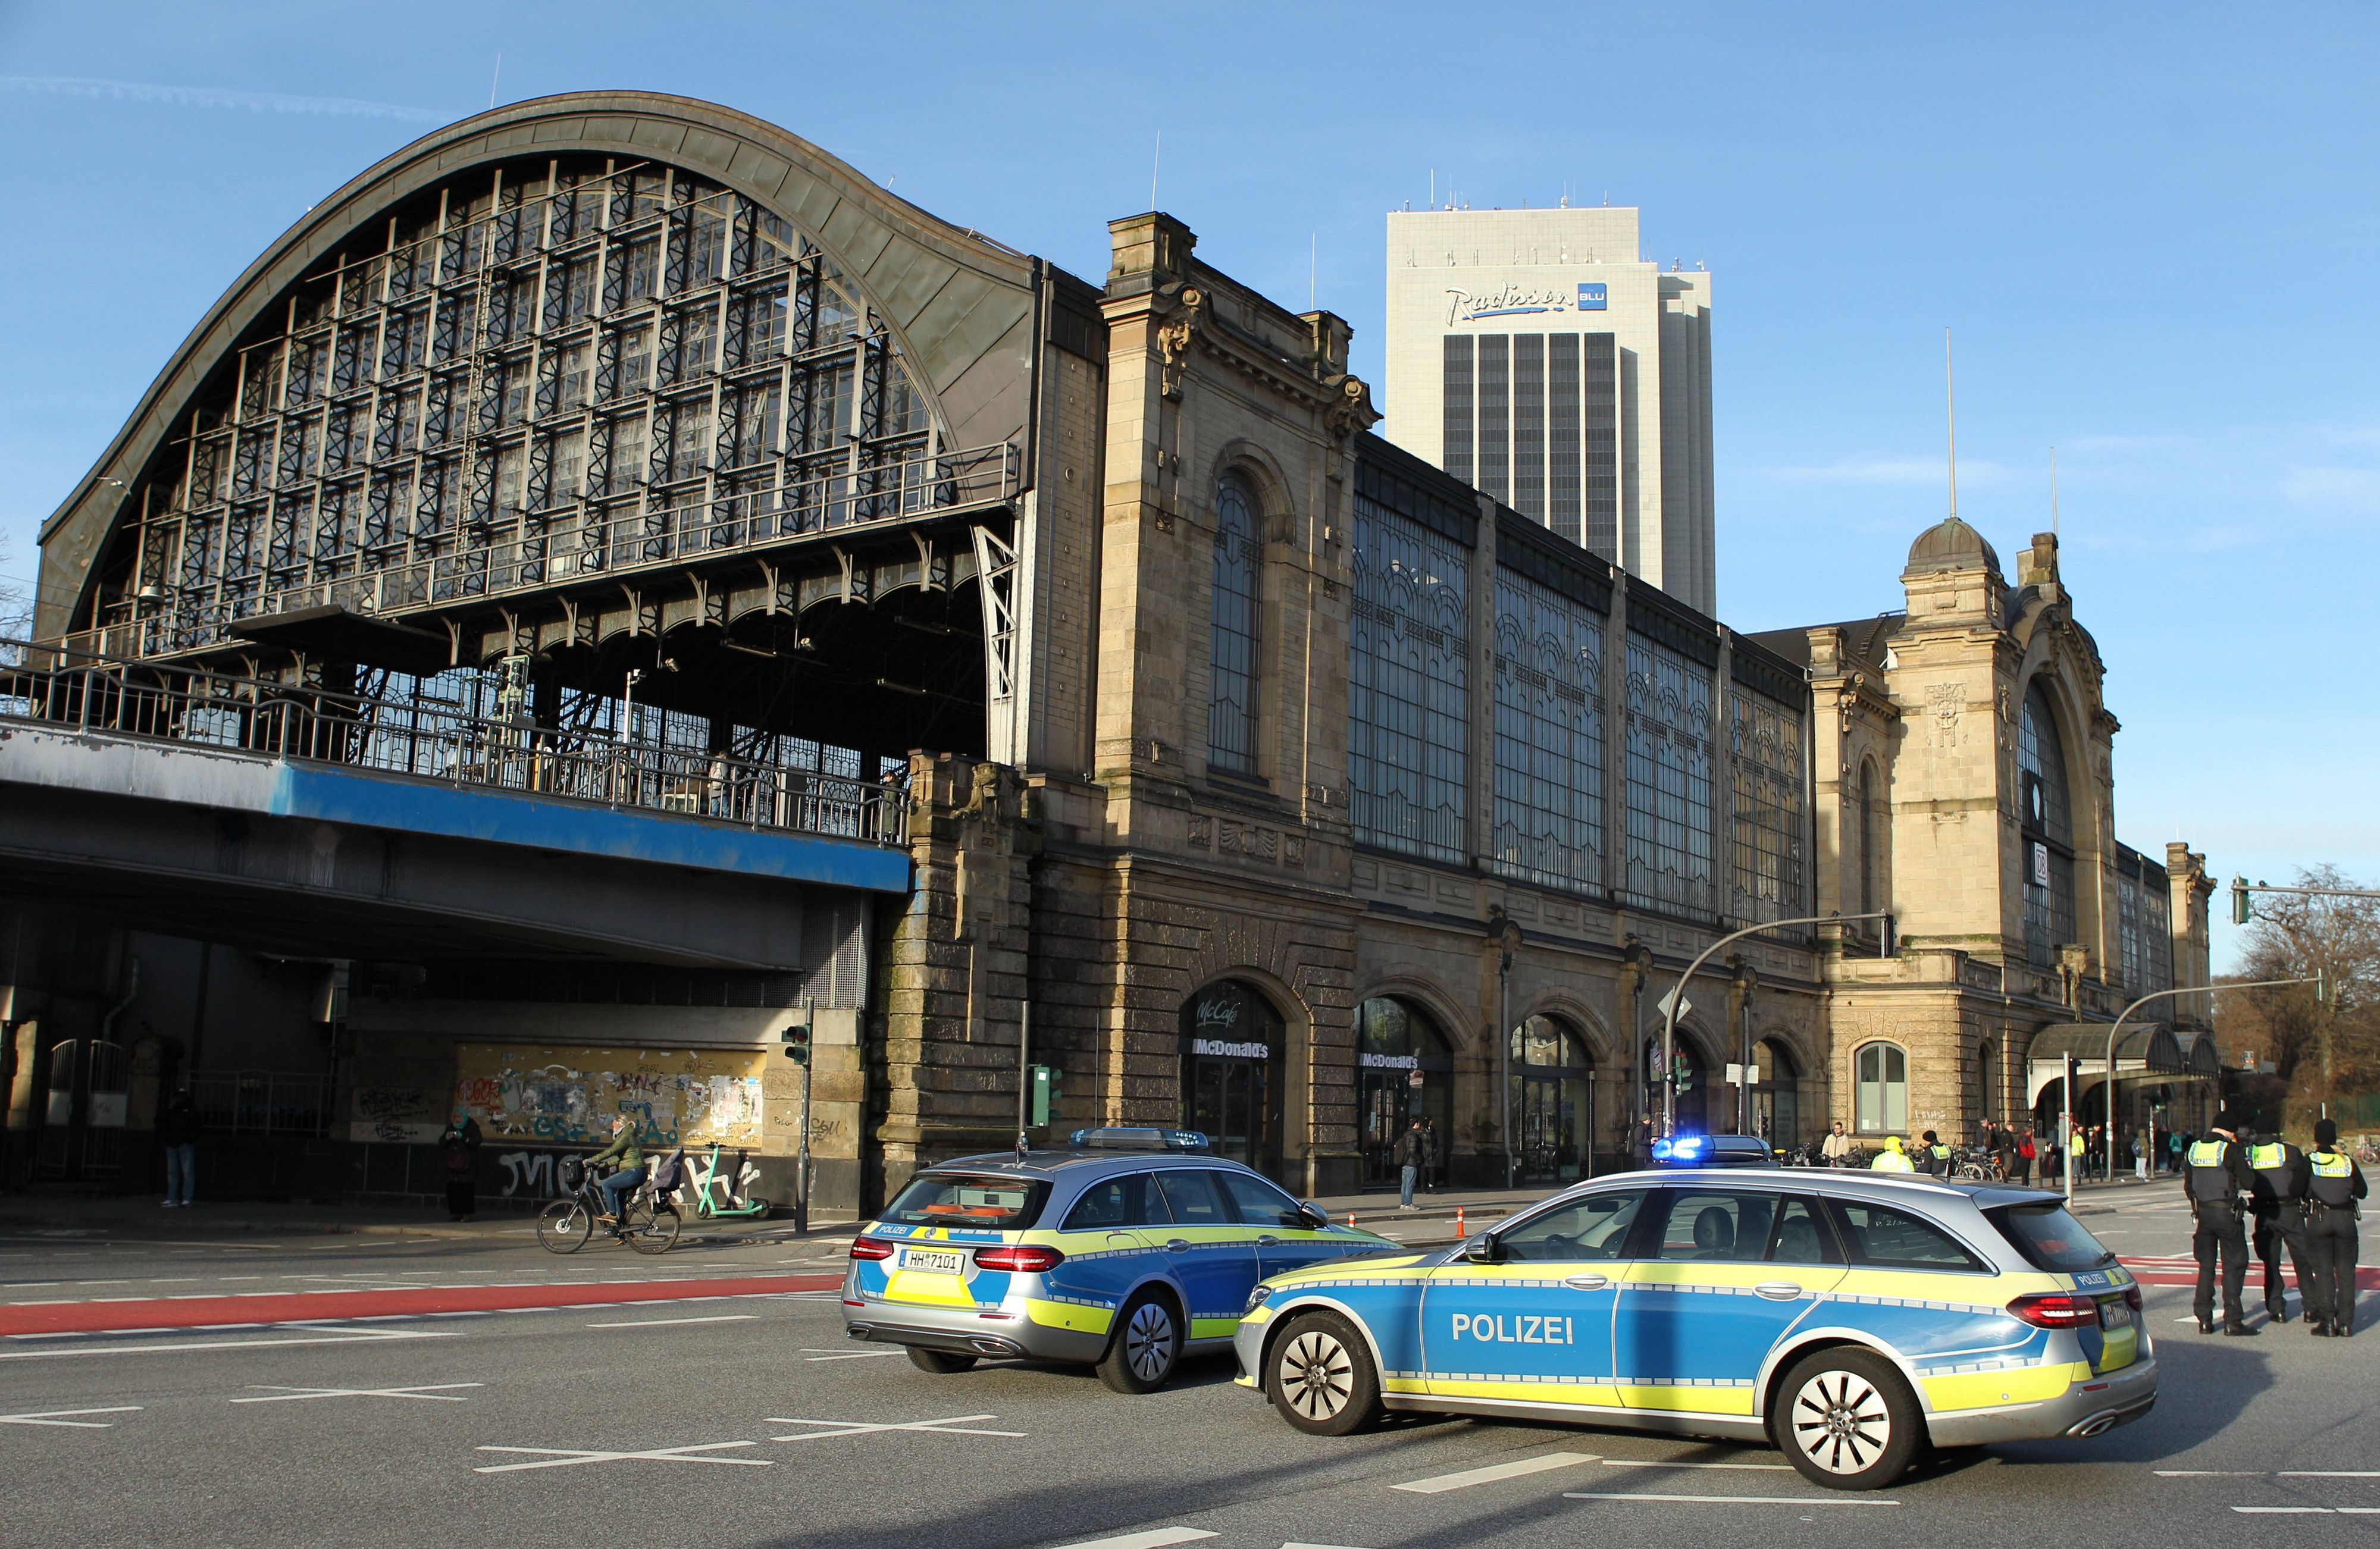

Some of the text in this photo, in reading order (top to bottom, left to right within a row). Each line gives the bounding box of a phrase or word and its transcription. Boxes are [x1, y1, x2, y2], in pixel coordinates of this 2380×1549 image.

[1445, 279, 1574, 327] Radisson
[1197, 1000, 1238, 1028] McCafé
[1193, 1039, 1268, 1058] McDonald's
[1360, 1053, 1418, 1069] McDonald's
[878, 1225, 908, 1234] POLIZEI
[910, 1253, 956, 1269] HH 7101
[2077, 1274, 2106, 1286] POLIZEI
[1452, 1313, 1573, 1344] POLIZEI
